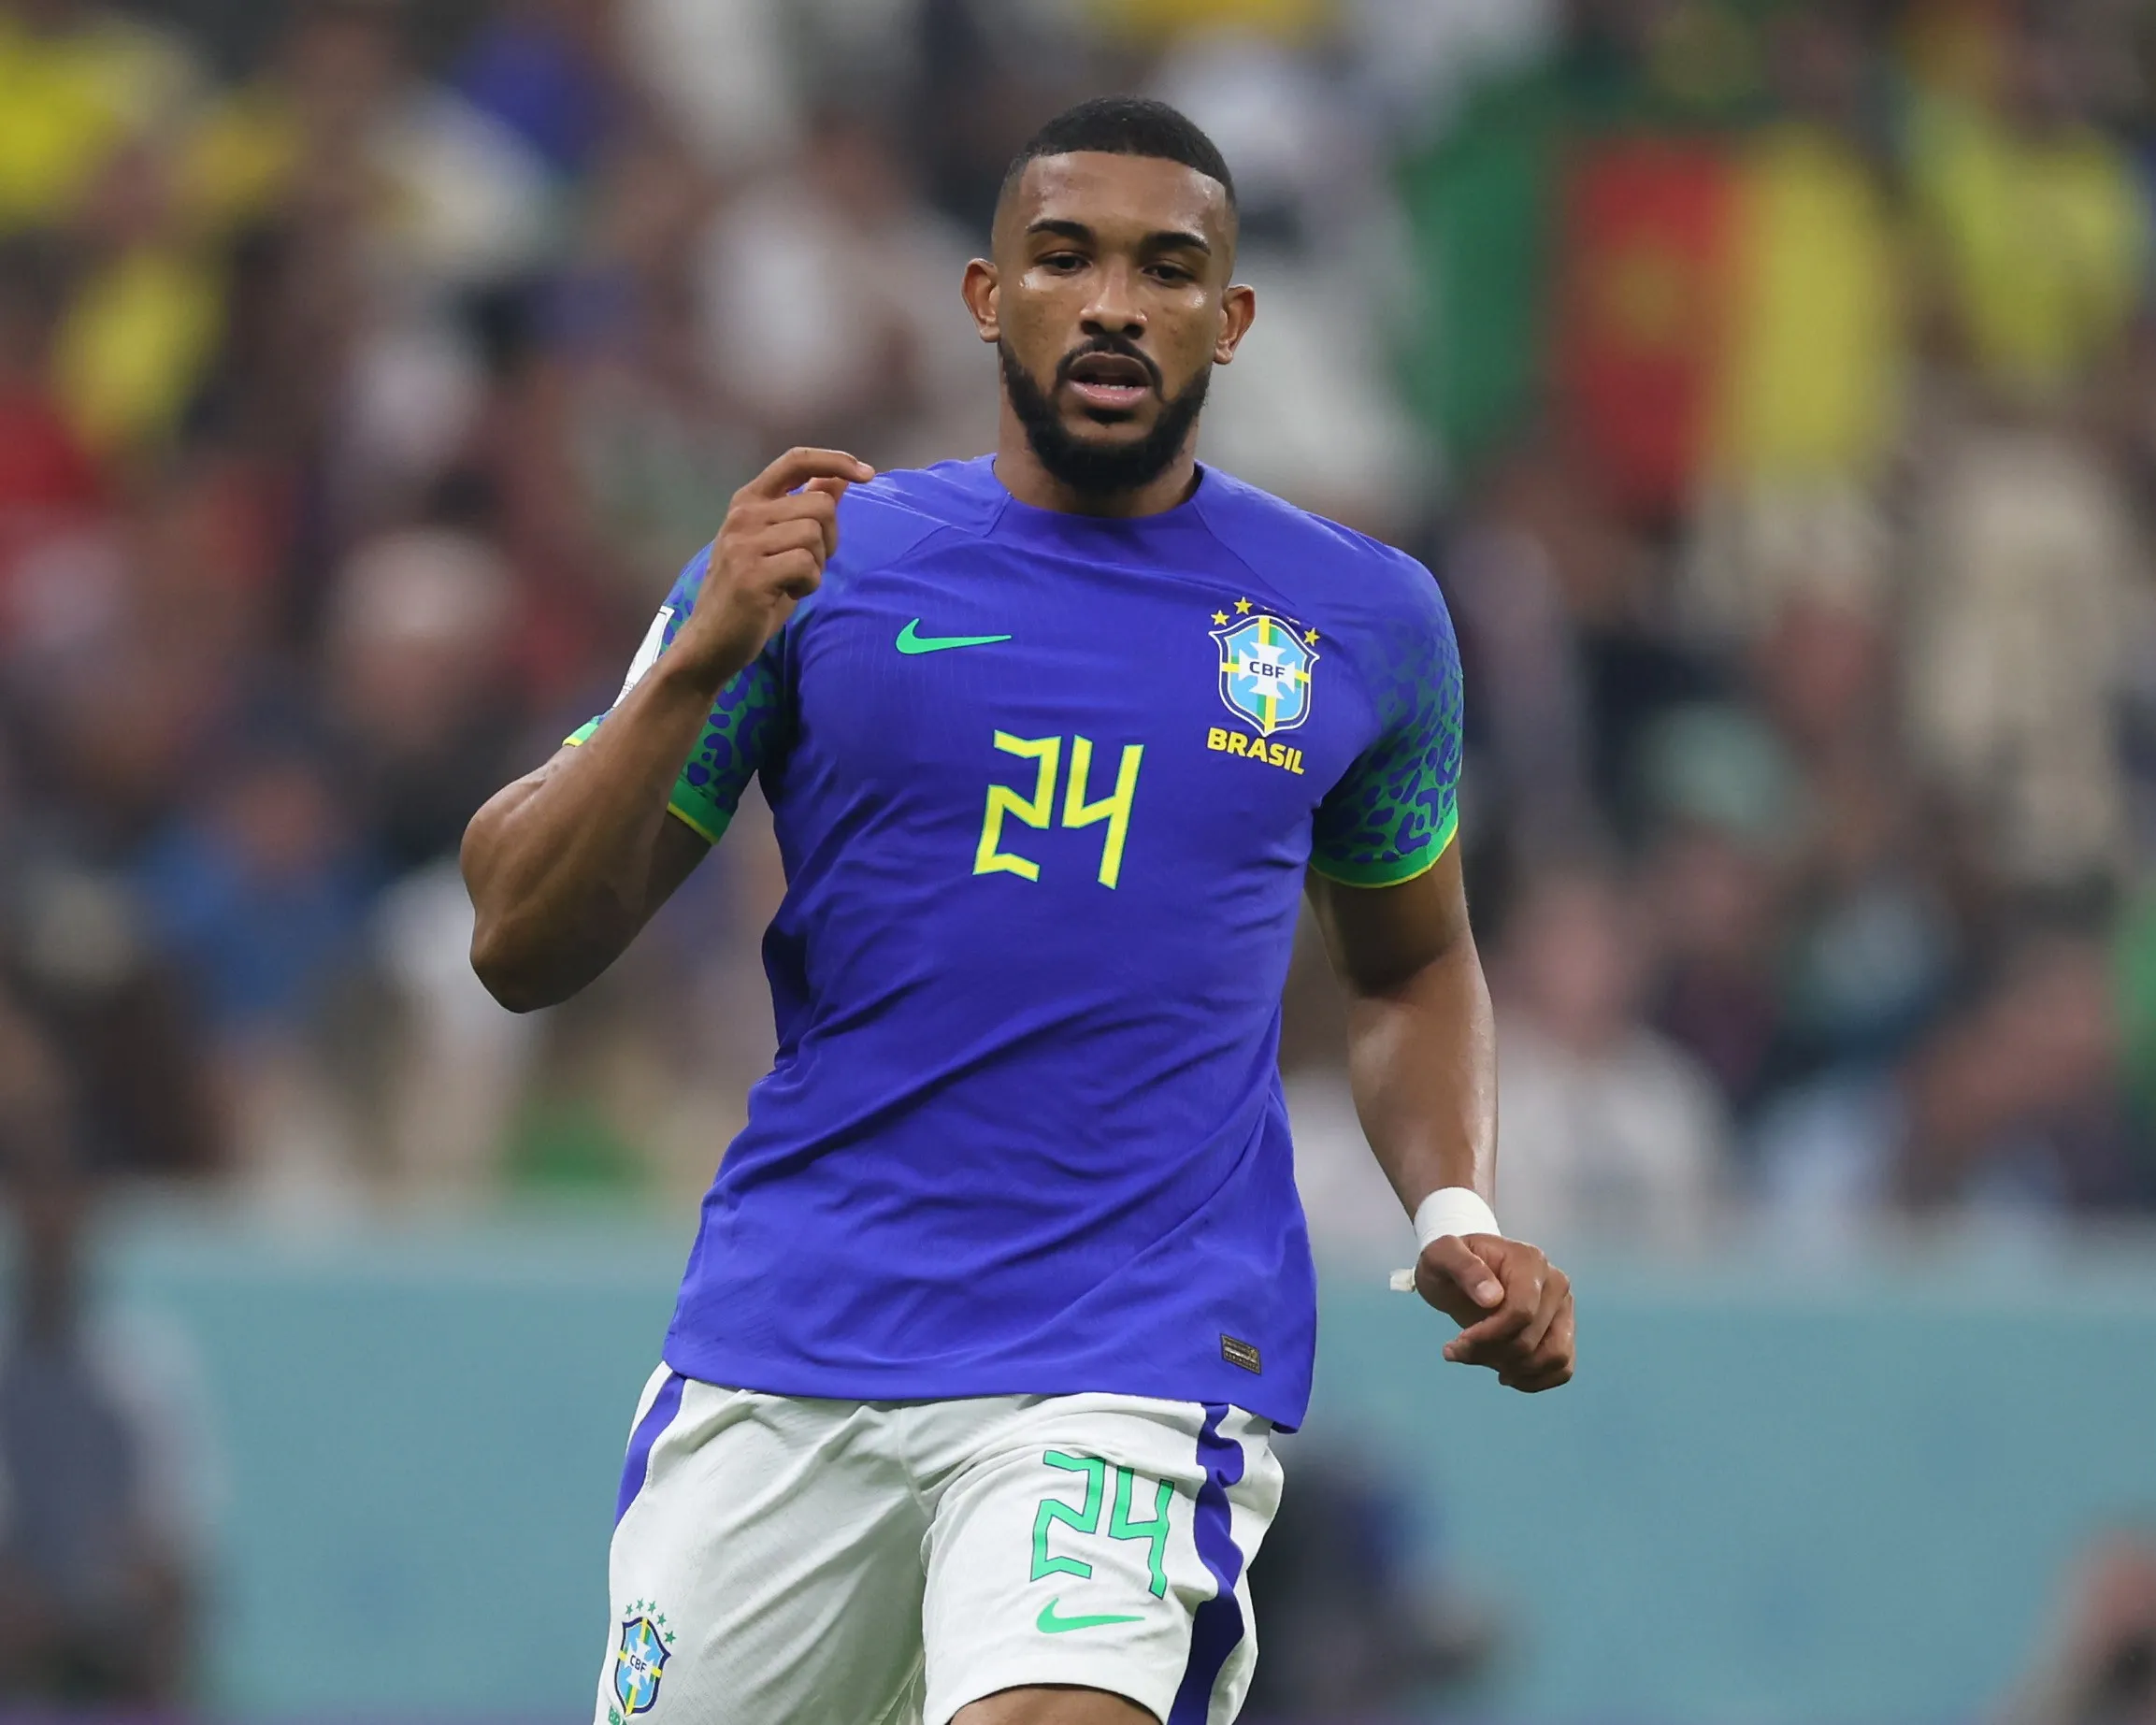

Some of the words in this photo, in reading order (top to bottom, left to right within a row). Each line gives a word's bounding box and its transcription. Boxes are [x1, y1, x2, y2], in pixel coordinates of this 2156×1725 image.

[1249, 661, 1286, 679] CBF
[1207, 727, 1305, 775] BRASIL
[972, 729, 1144, 890] 24
[1029, 1450, 1175, 1601] 24
[629, 1654, 648, 1673] CBF
